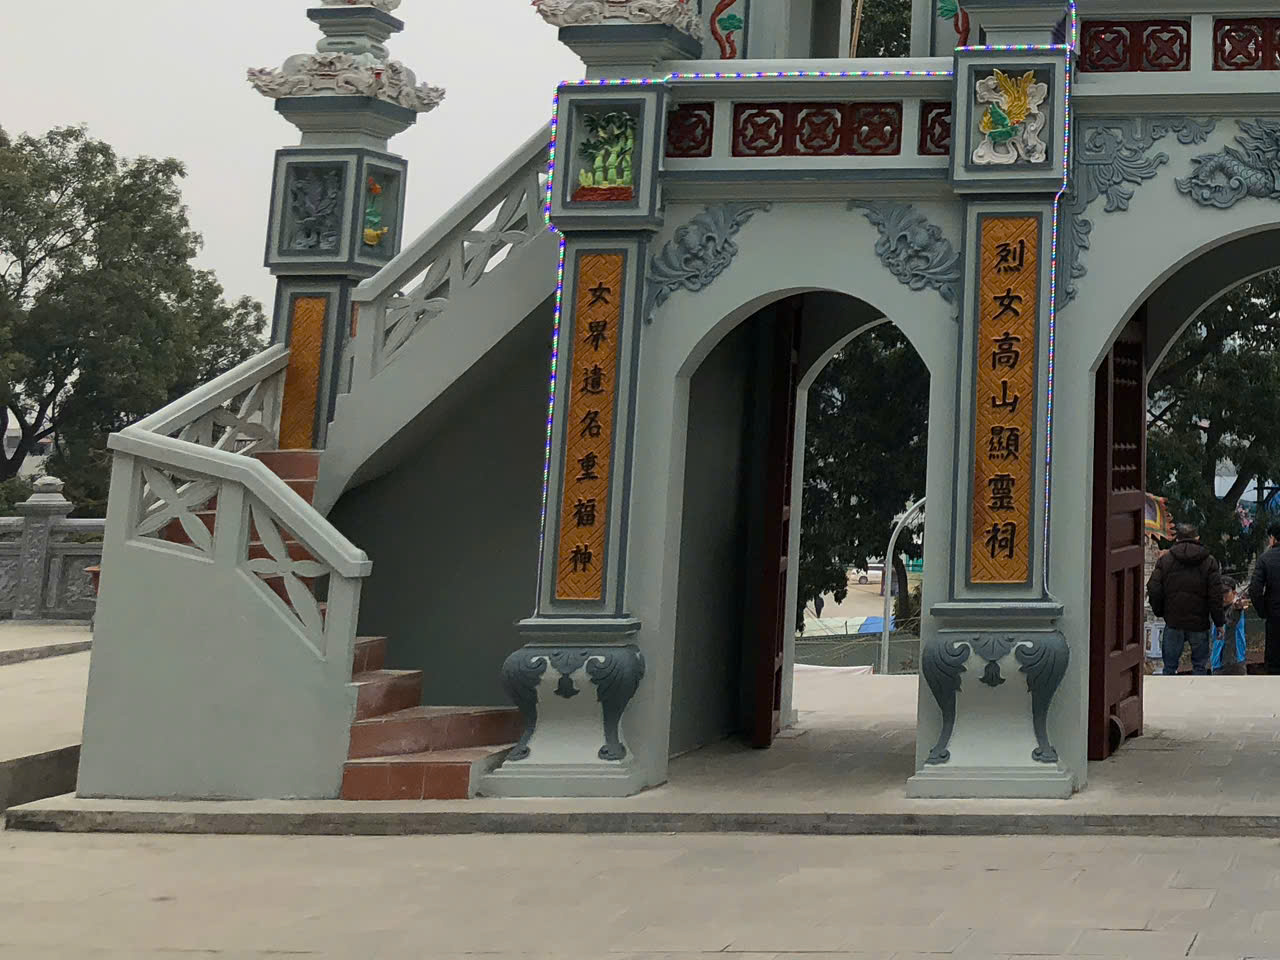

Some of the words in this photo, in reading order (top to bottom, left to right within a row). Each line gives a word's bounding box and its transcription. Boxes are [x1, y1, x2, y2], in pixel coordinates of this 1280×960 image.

[984, 238, 1026, 560] 烈女高山顯靈祠
